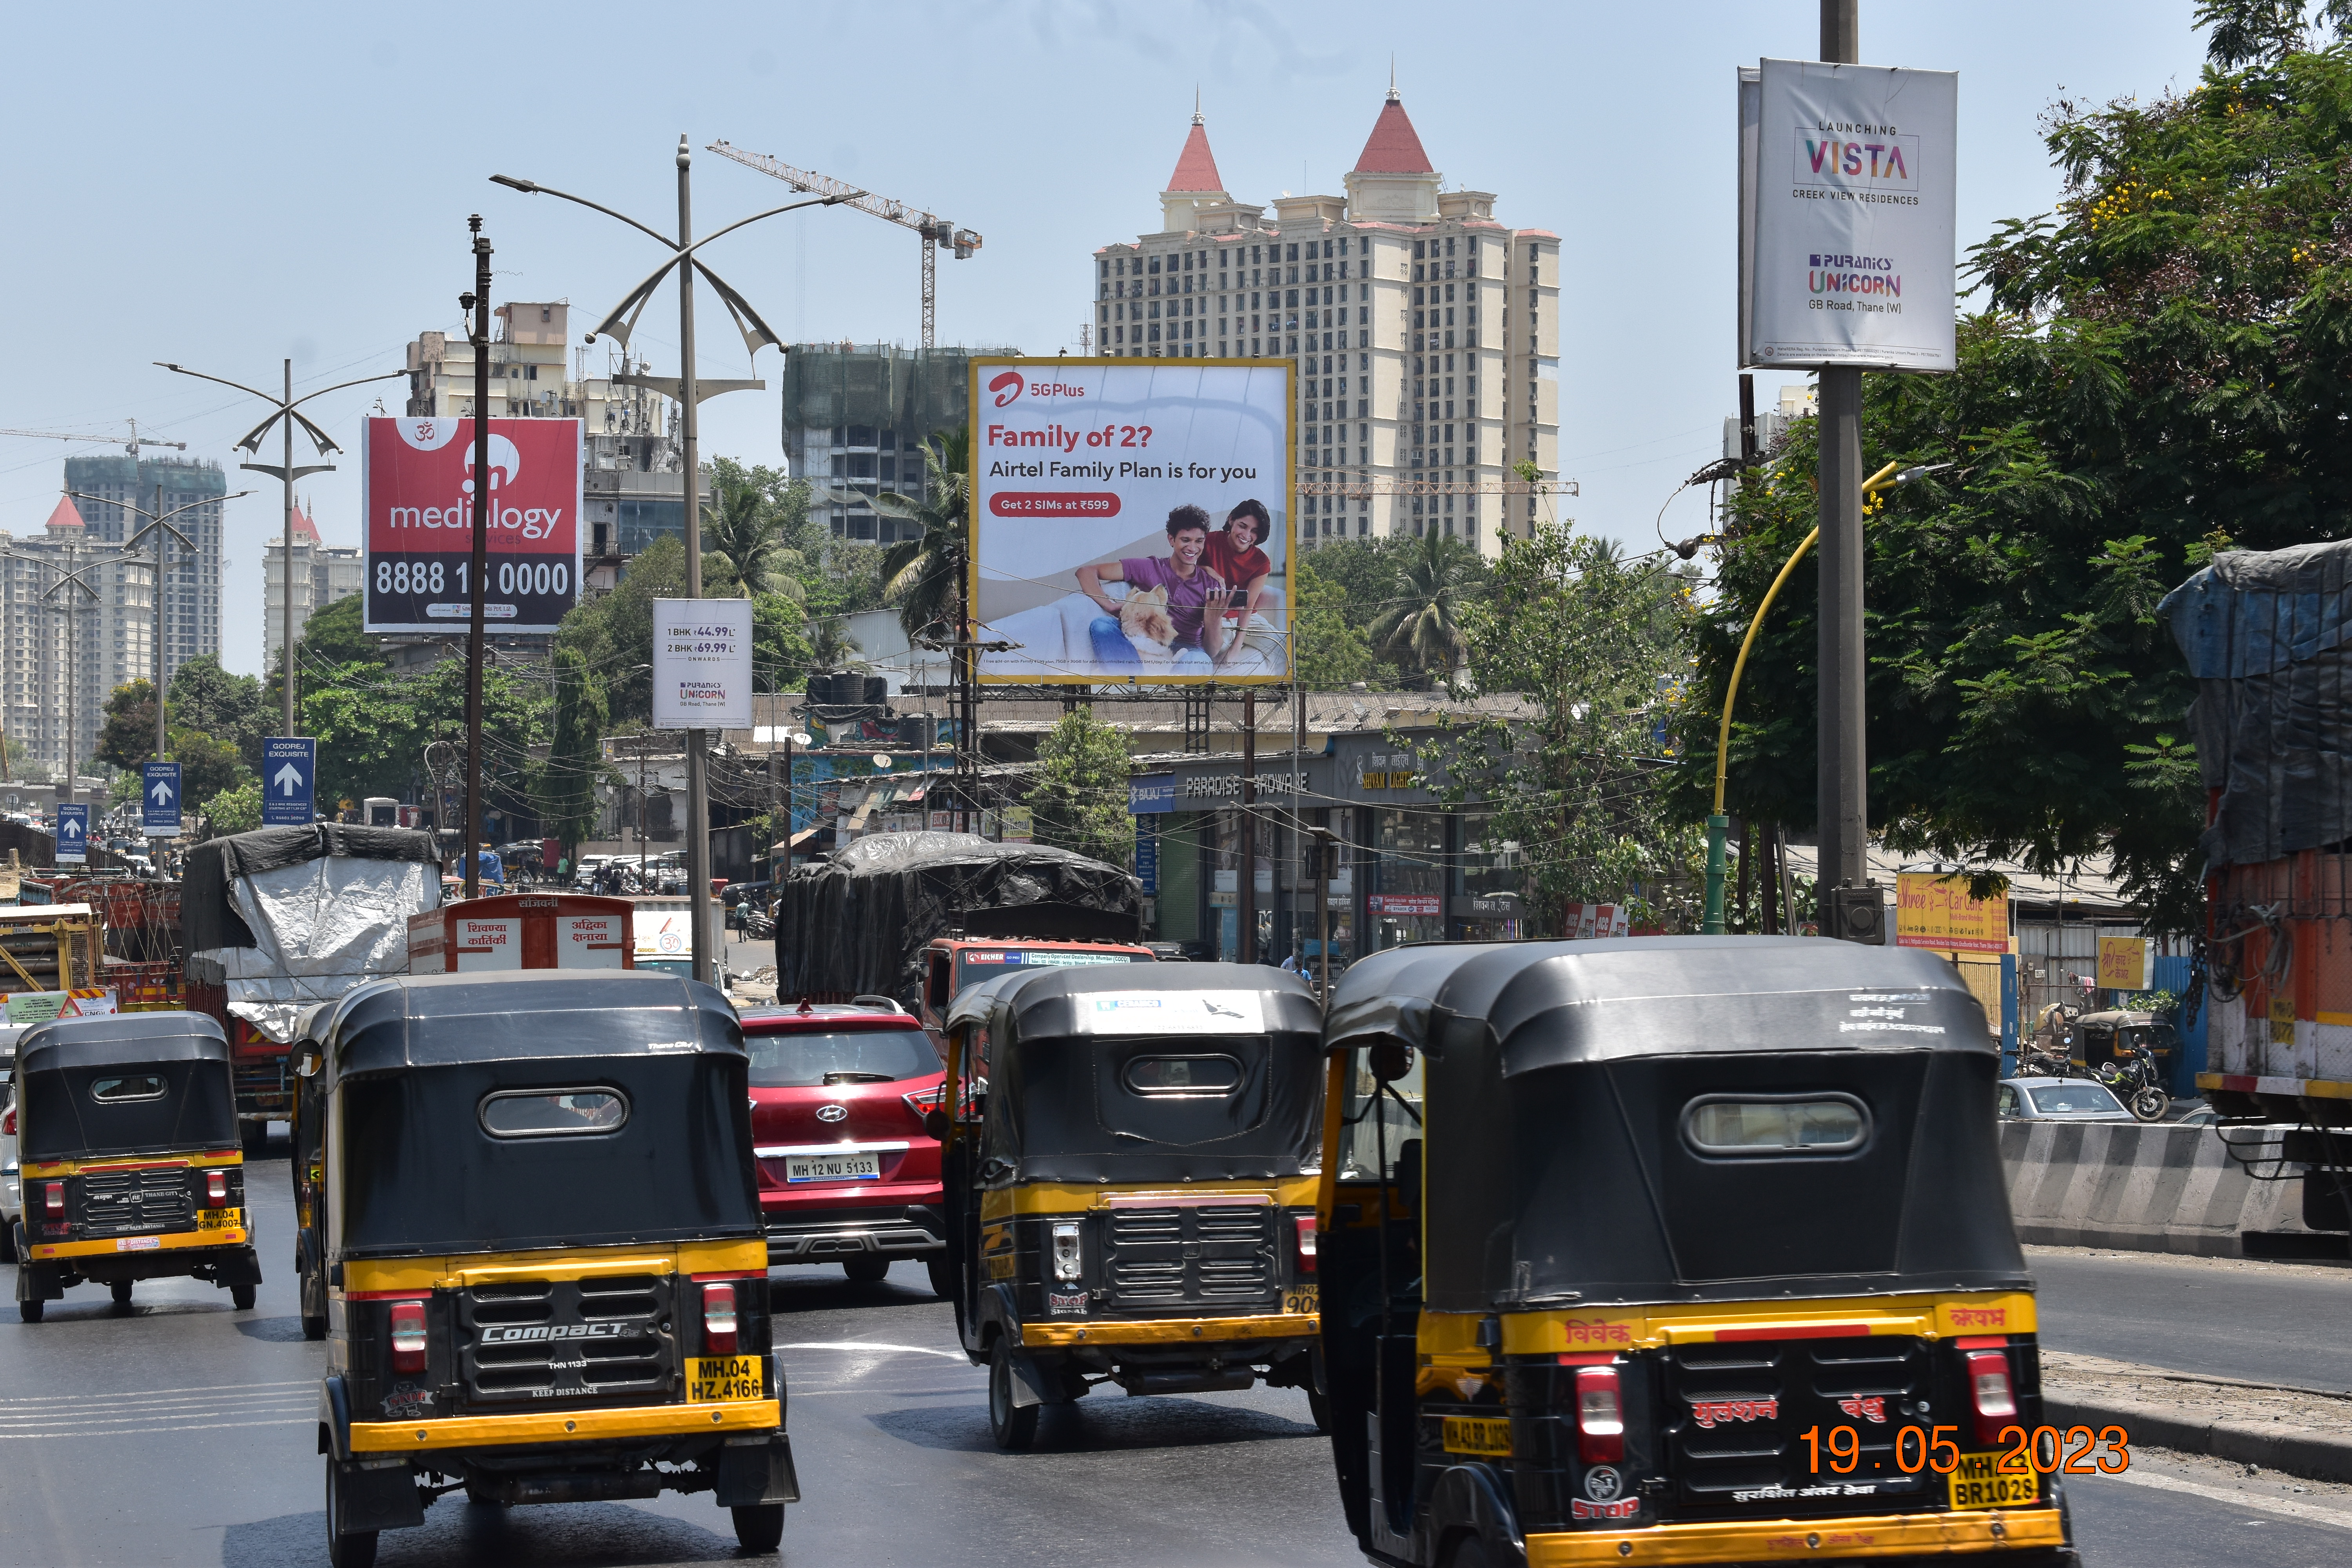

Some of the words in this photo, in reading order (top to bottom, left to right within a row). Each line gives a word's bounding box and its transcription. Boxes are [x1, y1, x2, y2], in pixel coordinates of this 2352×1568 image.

[1818, 122, 1896, 136] LAUNCHING
[1806, 140, 1907, 179] VISTA
[1793, 189, 1825, 200] CREEK
[1830, 191, 1856, 201] VIEW
[1859, 193, 1919, 205] RESIDENCES
[1809, 299, 1823, 310] GB
[1826, 299, 1854, 312] Road,
[1857, 301, 1884, 312] Thane
[1887, 303, 1901, 314] (W)
[989, 425, 1080, 453] Family
[1086, 425, 1114, 448] of
[1121, 425, 1152, 448] 2?
[989, 461, 1043, 477] Airtel
[1050, 462, 1114, 482] Family
[1120, 462, 1162, 479] Plan
[1168, 462, 1183, 479] is
[1189, 462, 1217, 479] for
[1221, 468, 1256, 483] you
[1001, 500, 1022, 510] Get
[1025, 500, 1031, 510] 2
[1034, 500, 1062, 510] SIMs
[1065, 501, 1077, 510] at
[1080, 500, 1109, 510] ₹599
[377, 561, 445, 594] 8888
[499, 563, 568, 595] 0000
[680, 689, 726, 700] UNICORN
[1187, 775, 1240, 798] PARADISE
[1363, 773, 1385, 789] SHIVAM
[1139, 788, 1160, 800] BAJAJ
[518, 896, 559, 908] संजिवनी
[1898, 878, 1926, 909] Shree
[1949, 891, 1963, 910] Car
[467, 922, 507, 933] शिवण्या
[1566, 914, 1578, 926] ACC
[1597, 917, 1608, 930] ACC
[793, 1165, 809, 1176] MH
[812, 1164, 824, 1175] 12
[827, 1163, 841, 1174] NU
[847, 1161, 873, 1173] 5133
[203, 1210, 234, 1220] MH.04
[198, 1219, 238, 1229] GN.4007
[1049, 1292, 1088, 1306] STOP
[1564, 1319, 1631, 1344] विवेक
[698, 1360, 750, 1379] MH.04
[556, 1387, 598, 1396] DISTANCE
[691, 1379, 760, 1401] HZ.4166
[1691, 1399, 1779, 1428] गुलशन
[1798, 1485, 1841, 1497] अंतर
[1956, 1478, 2033, 1505] BR1028
[1572, 1496, 1641, 1520] STOP
